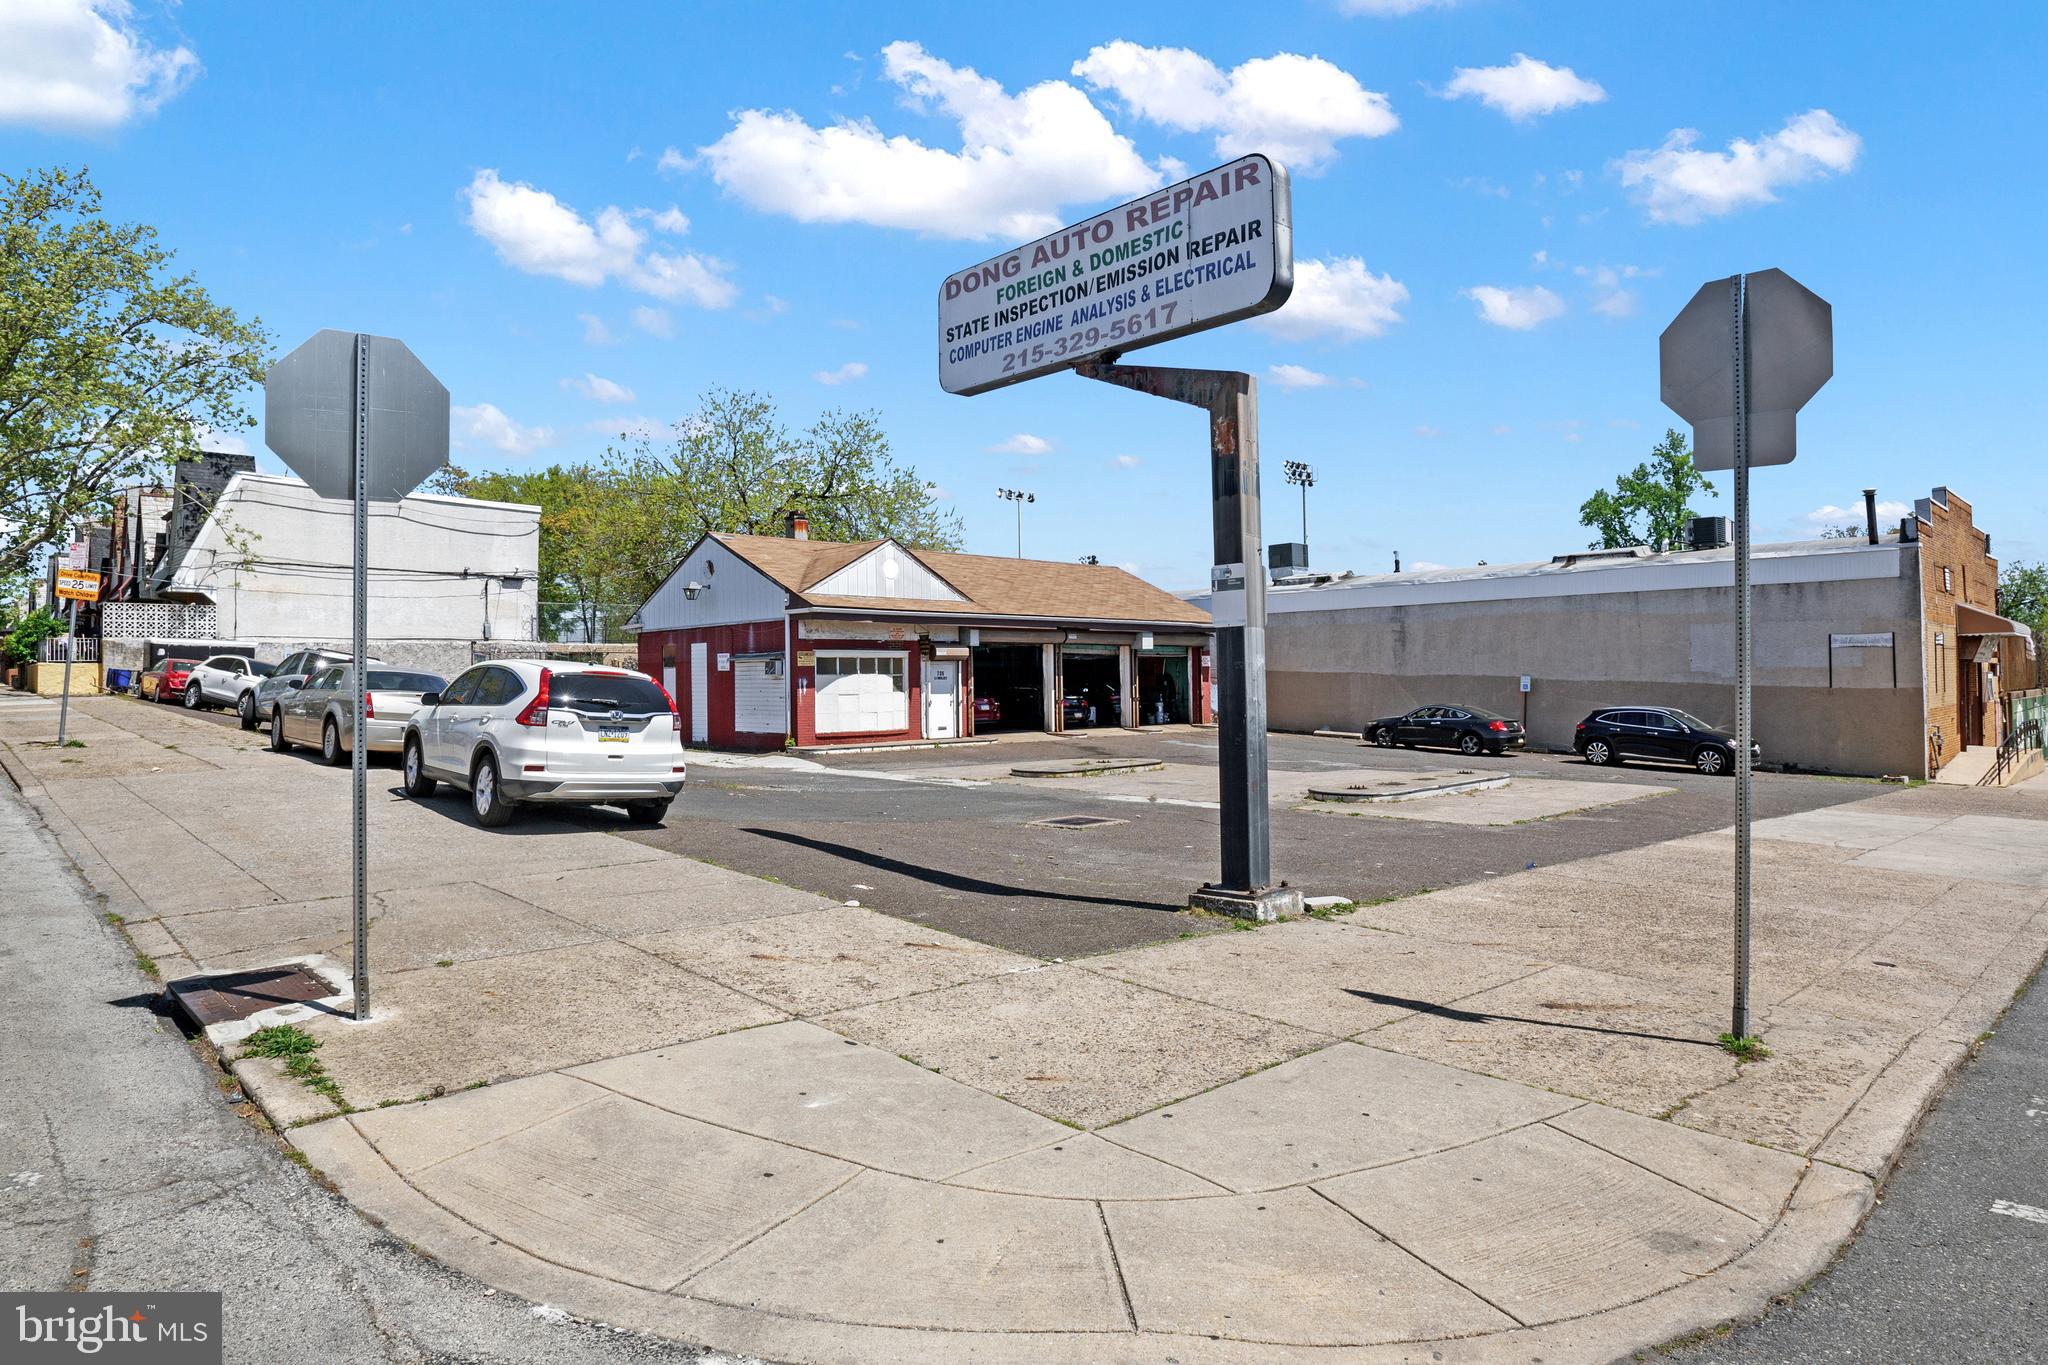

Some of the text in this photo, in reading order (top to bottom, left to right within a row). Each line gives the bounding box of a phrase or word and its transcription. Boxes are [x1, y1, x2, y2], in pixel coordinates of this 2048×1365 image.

[945, 162, 1262, 301] DONG AUTO REPAIR
[946, 219, 1263, 343] STATE INSPECTION/EMISSION REPAIR
[996, 220, 1184, 305] FOREIGN & DOMESTIC
[949, 250, 1257, 364] COMPUTER ENGINE ANALYSIS & ELECTRICAL
[1002, 301, 1178, 373] 215-329-5617
[72, 580, 85, 589] 25
